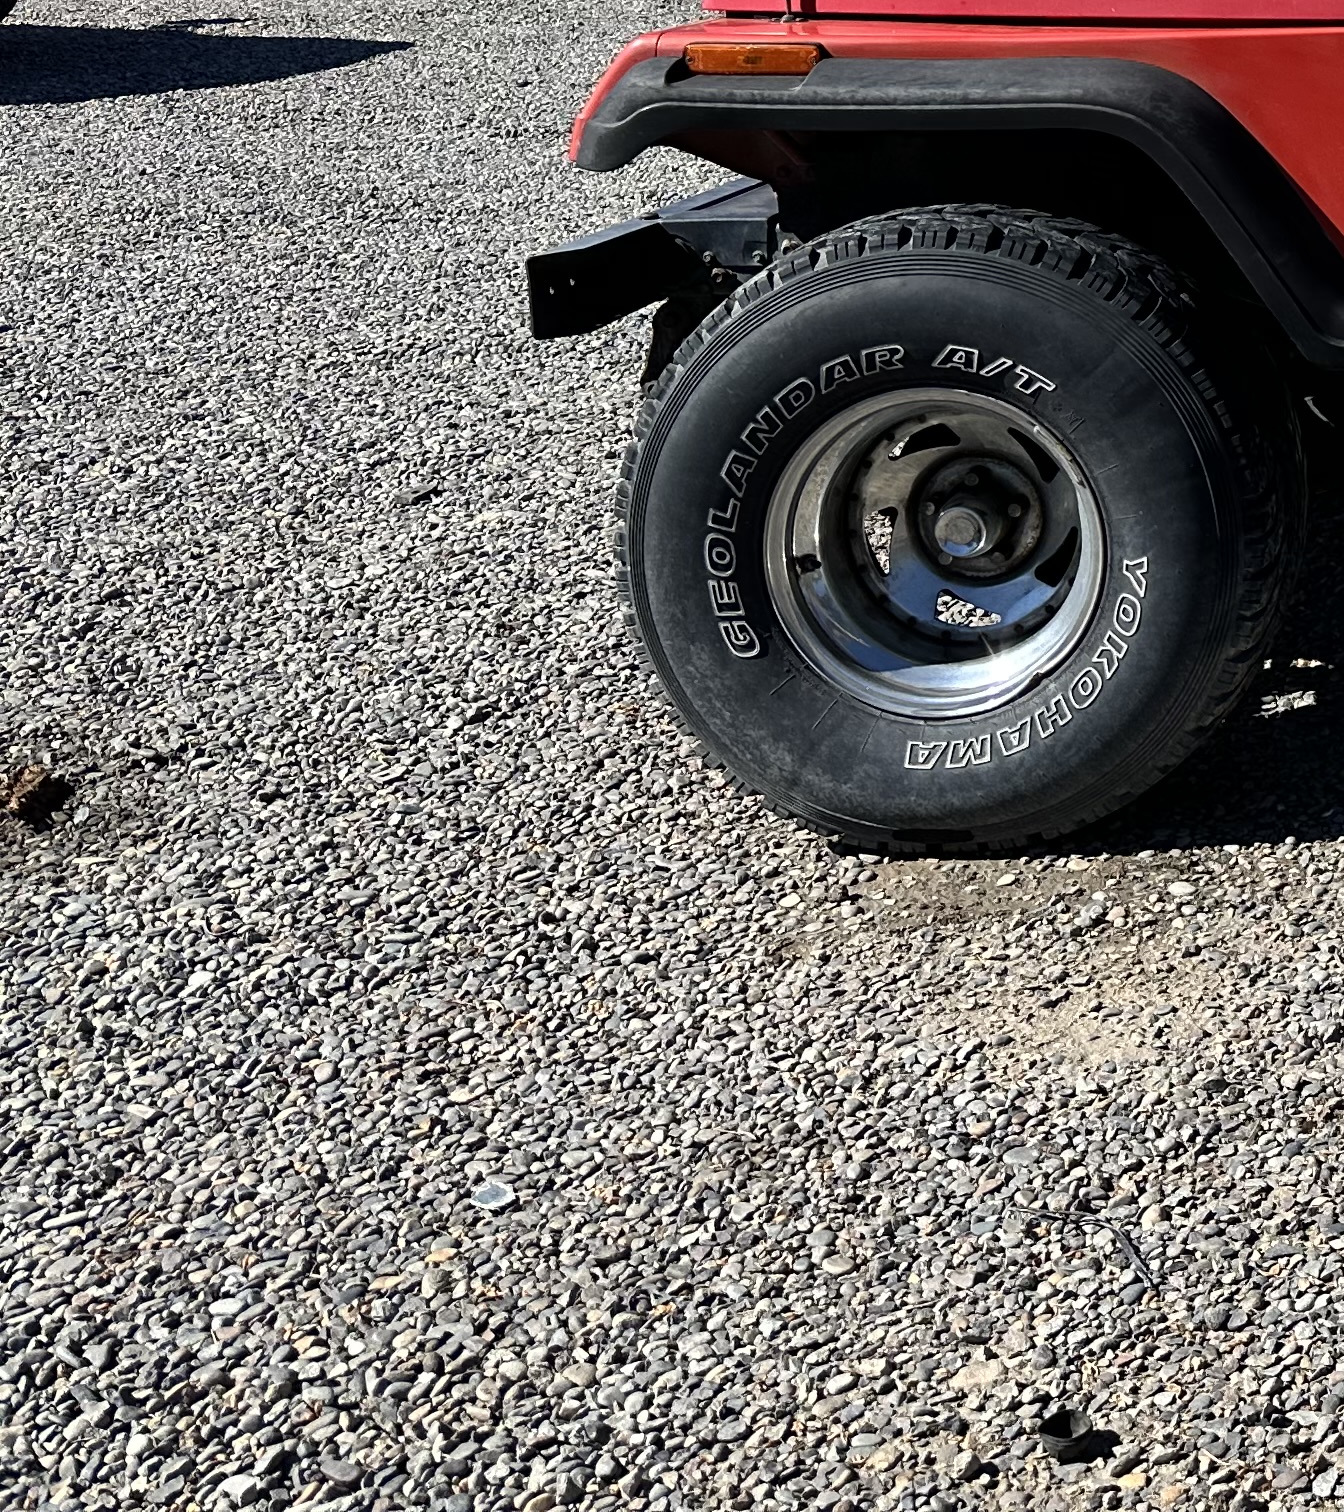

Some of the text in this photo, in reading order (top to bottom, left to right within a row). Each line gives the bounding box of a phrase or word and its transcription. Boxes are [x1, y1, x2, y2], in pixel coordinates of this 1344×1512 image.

[704, 344, 1056, 659] GEOLANDAR A/T
[904, 555, 1148, 770] YOKOHAMA
